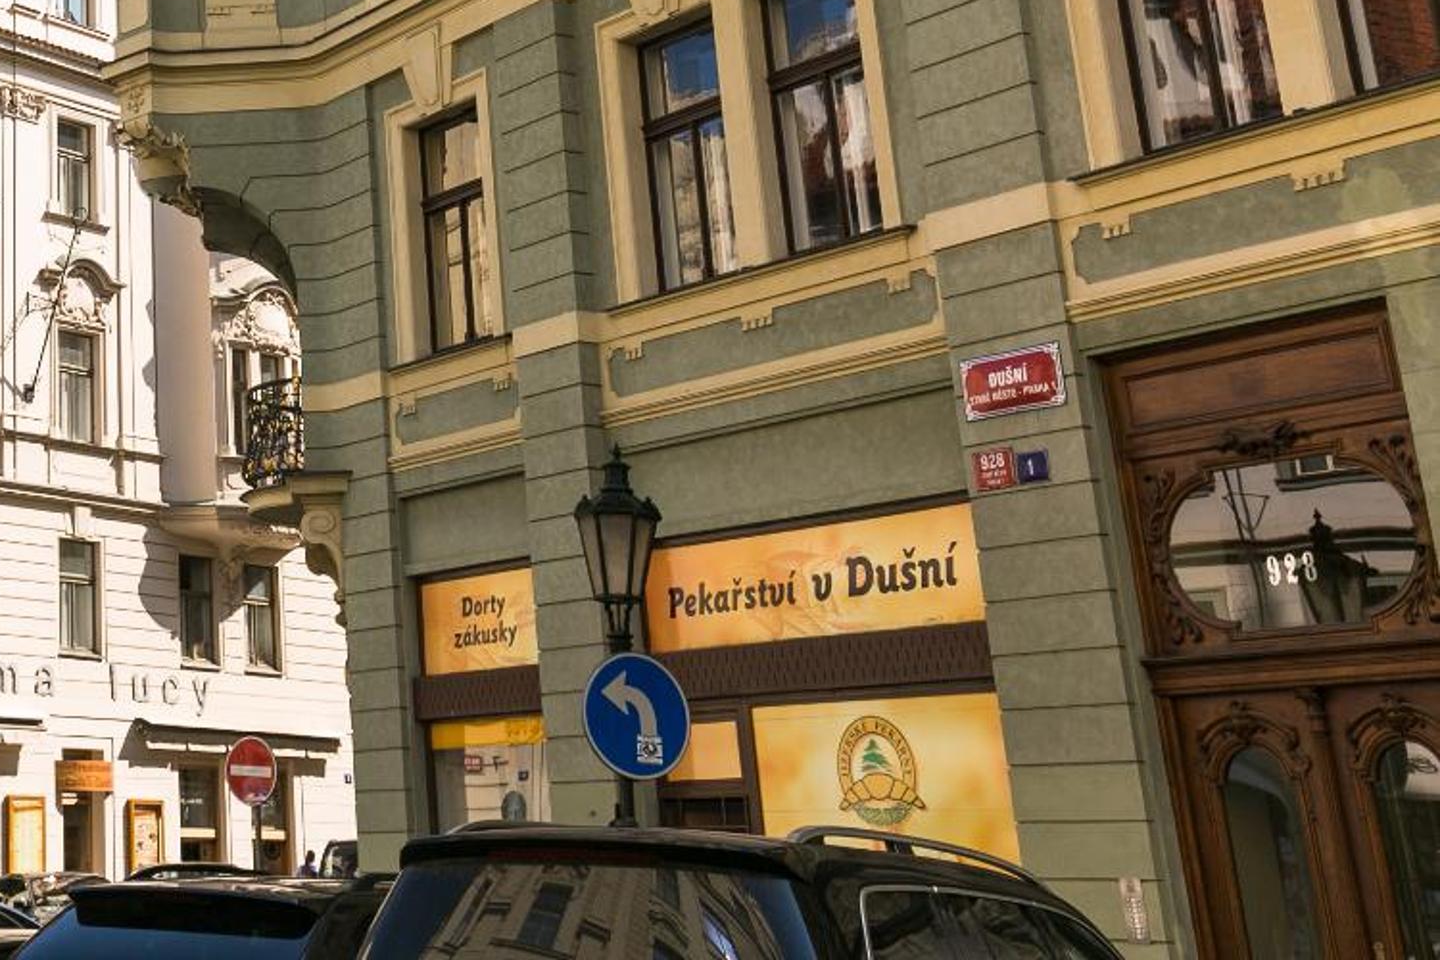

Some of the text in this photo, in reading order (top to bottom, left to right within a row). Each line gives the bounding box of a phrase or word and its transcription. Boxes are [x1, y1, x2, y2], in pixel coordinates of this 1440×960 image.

[988, 363, 1028, 388] DUŠNÍ
[980, 452, 1005, 471] 928
[668, 541, 958, 619] Pekařství v Dušní
[1266, 551, 1318, 586] 928
[462, 595, 505, 618] Dorty
[454, 620, 517, 649] zákusky
[109, 663, 208, 717] lucy
